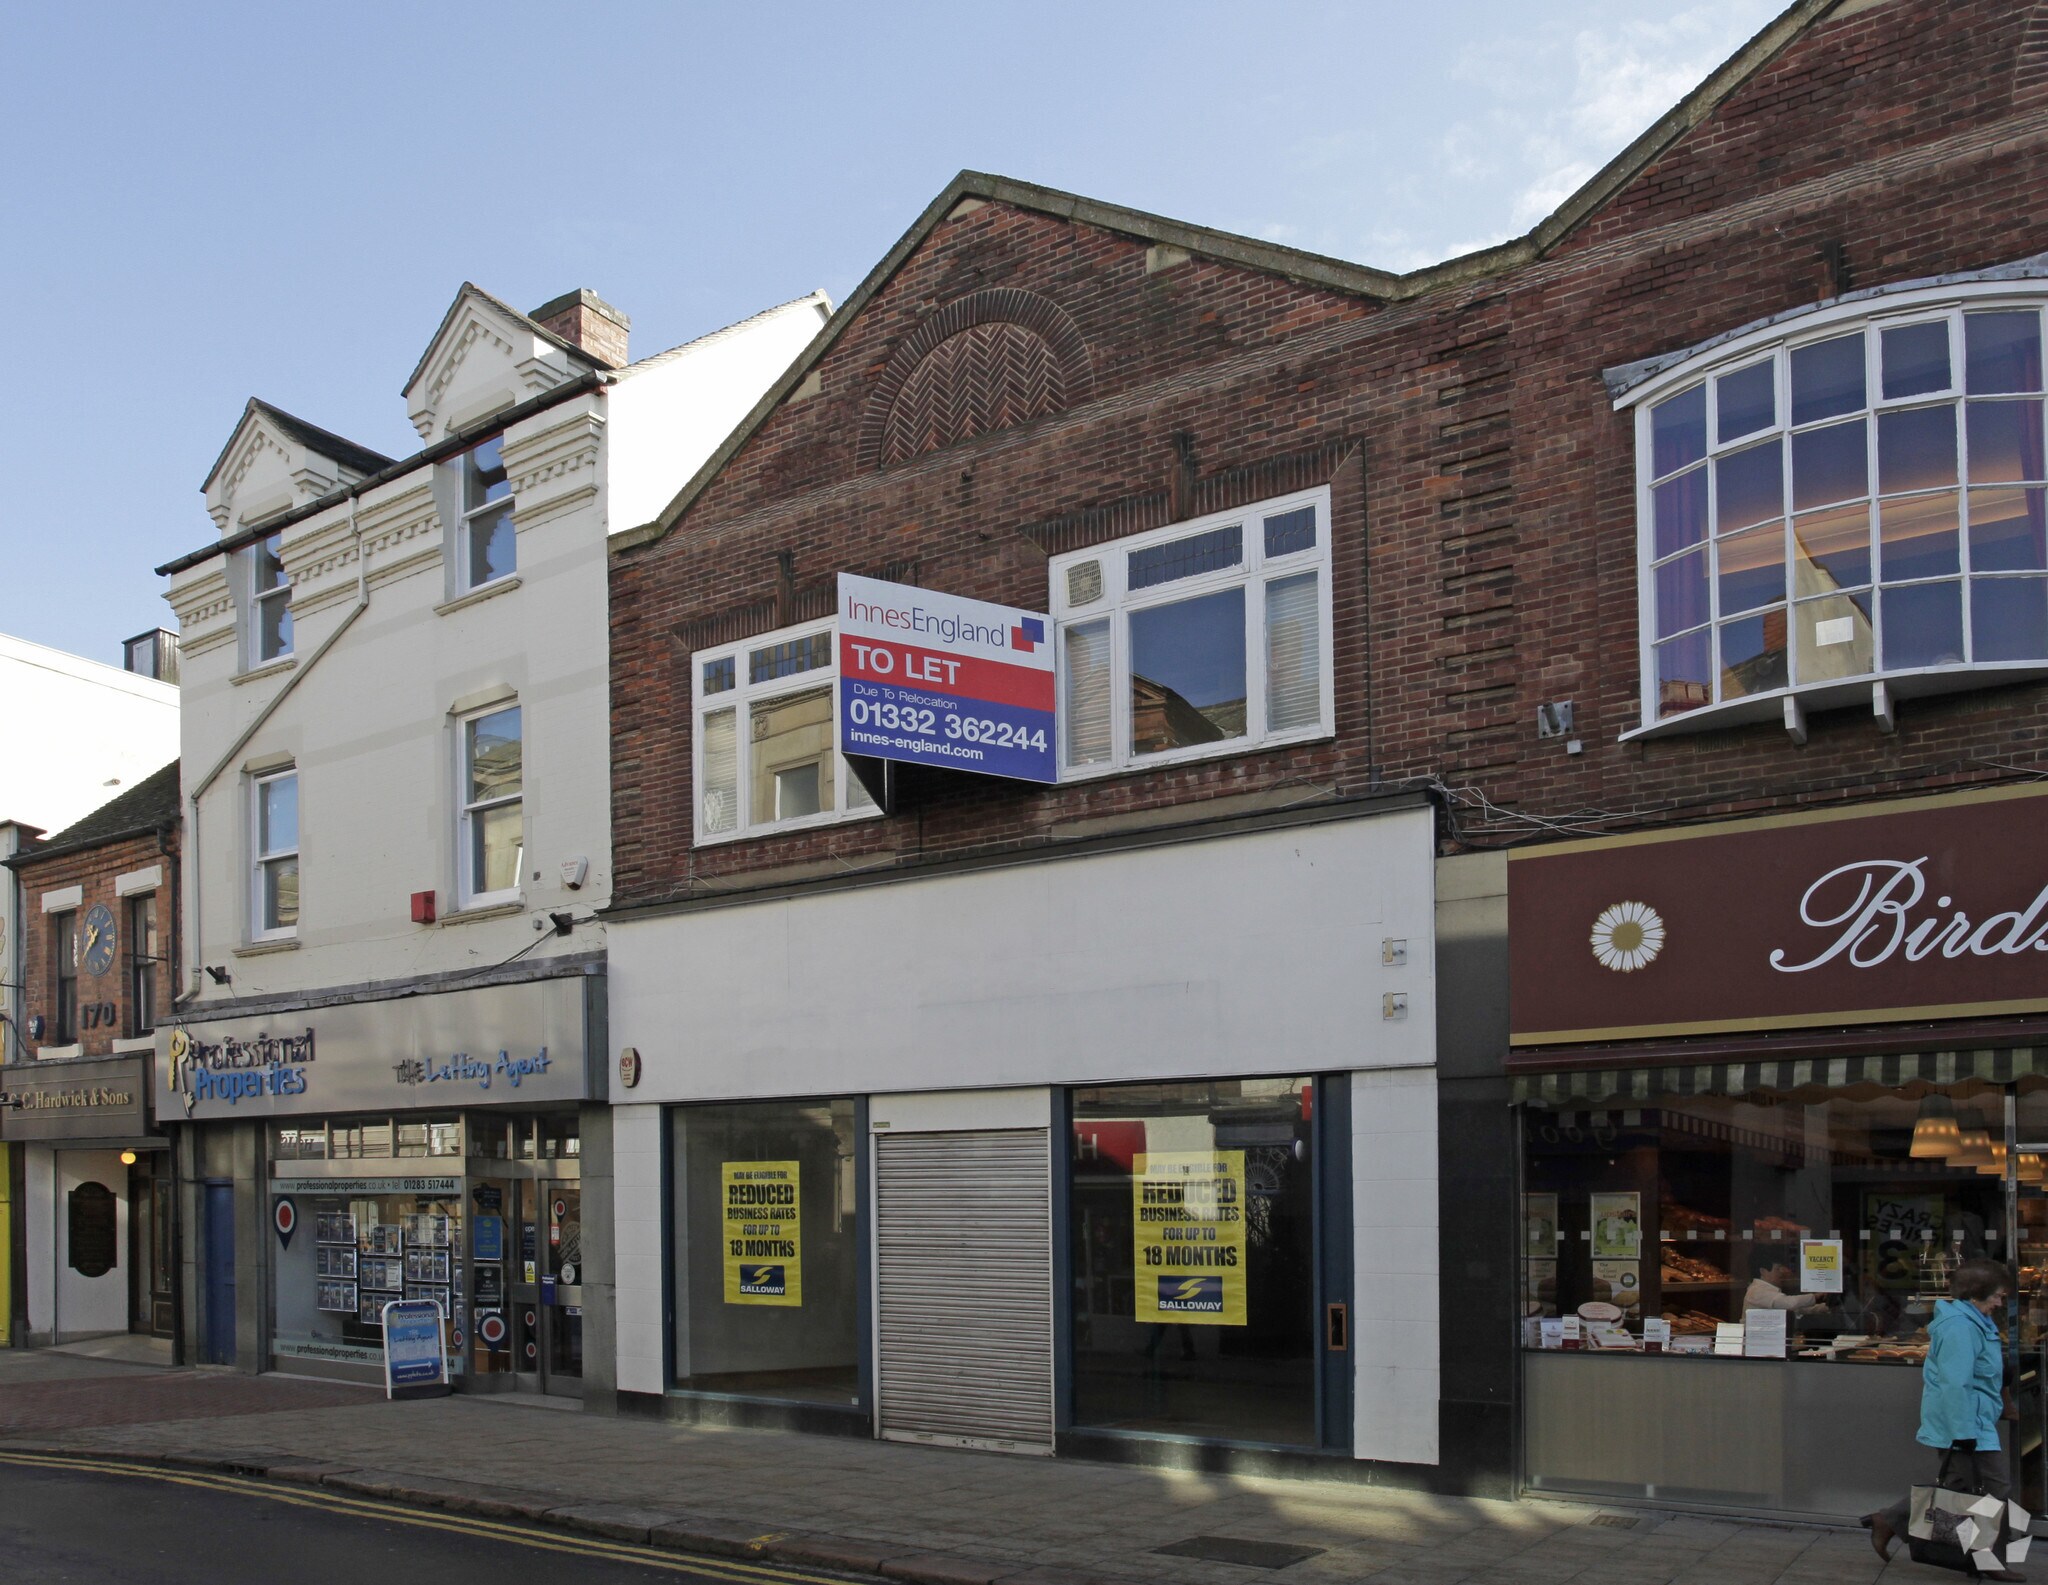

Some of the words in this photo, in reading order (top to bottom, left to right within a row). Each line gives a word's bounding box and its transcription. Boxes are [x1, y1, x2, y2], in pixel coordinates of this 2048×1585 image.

[849, 595, 1005, 648] InnesEngland
[851, 643, 894, 674] TO
[905, 653, 961, 685] LET
[853, 683, 879, 697] Due
[881, 688, 895, 700] To
[899, 691, 958, 711] Relocation
[850, 699, 936, 736] 01332
[944, 714, 1048, 753] 362244
[851, 728, 984, 761] innes-england.com
[81, 1001, 117, 1030] 170
[188, 1026, 316, 1071] Professional
[424, 1051, 491, 1090] Letting
[495, 1046, 553, 1088] Agent
[195, 1061, 306, 1106] Properties
[36, 1088, 88, 1109] Hardwick
[90, 1087, 100, 1106] &
[101, 1086, 129, 1106] Sons
[734, 1171, 745, 1180] MAY
[746, 1171, 753, 1180] BE
[754, 1170, 777, 1180] ELIGIBLE
[777, 1170, 788, 1179] FOR
[1149, 1164, 1166, 1175] MAY
[1167, 1164, 1177, 1174] BE
[1213, 1162, 1228, 1173] FOR
[403, 1179, 426, 1191] 01283
[427, 1179, 455, 1191] 517444
[729, 1183, 795, 1206] REDUCED
[1142, 1177, 1237, 1204] REDUCED
[727, 1207, 769, 1220] BUSINESS
[770, 1207, 796, 1220] RATES
[1140, 1206, 1201, 1222] BUSINESS
[1202, 1206, 1240, 1222] RATES
[743, 1224, 758, 1236] FOR
[758, 1224, 769, 1236] UP
[770, 1224, 780, 1236] TO
[1162, 1227, 1184, 1241] FOR
[1185, 1227, 1200, 1241] UP
[1201, 1227, 1216, 1241] TO
[729, 1239, 743, 1257] 18
[745, 1239, 795, 1258] MONTHS
[1142, 1245, 1162, 1266] 18
[1166, 1245, 1238, 1267] MONTHS
[1808, 1255, 1835, 1264] VACANCY
[740, 1284, 785, 1295] SALLOWAY
[1159, 1300, 1222, 1311] SALLOWAY
